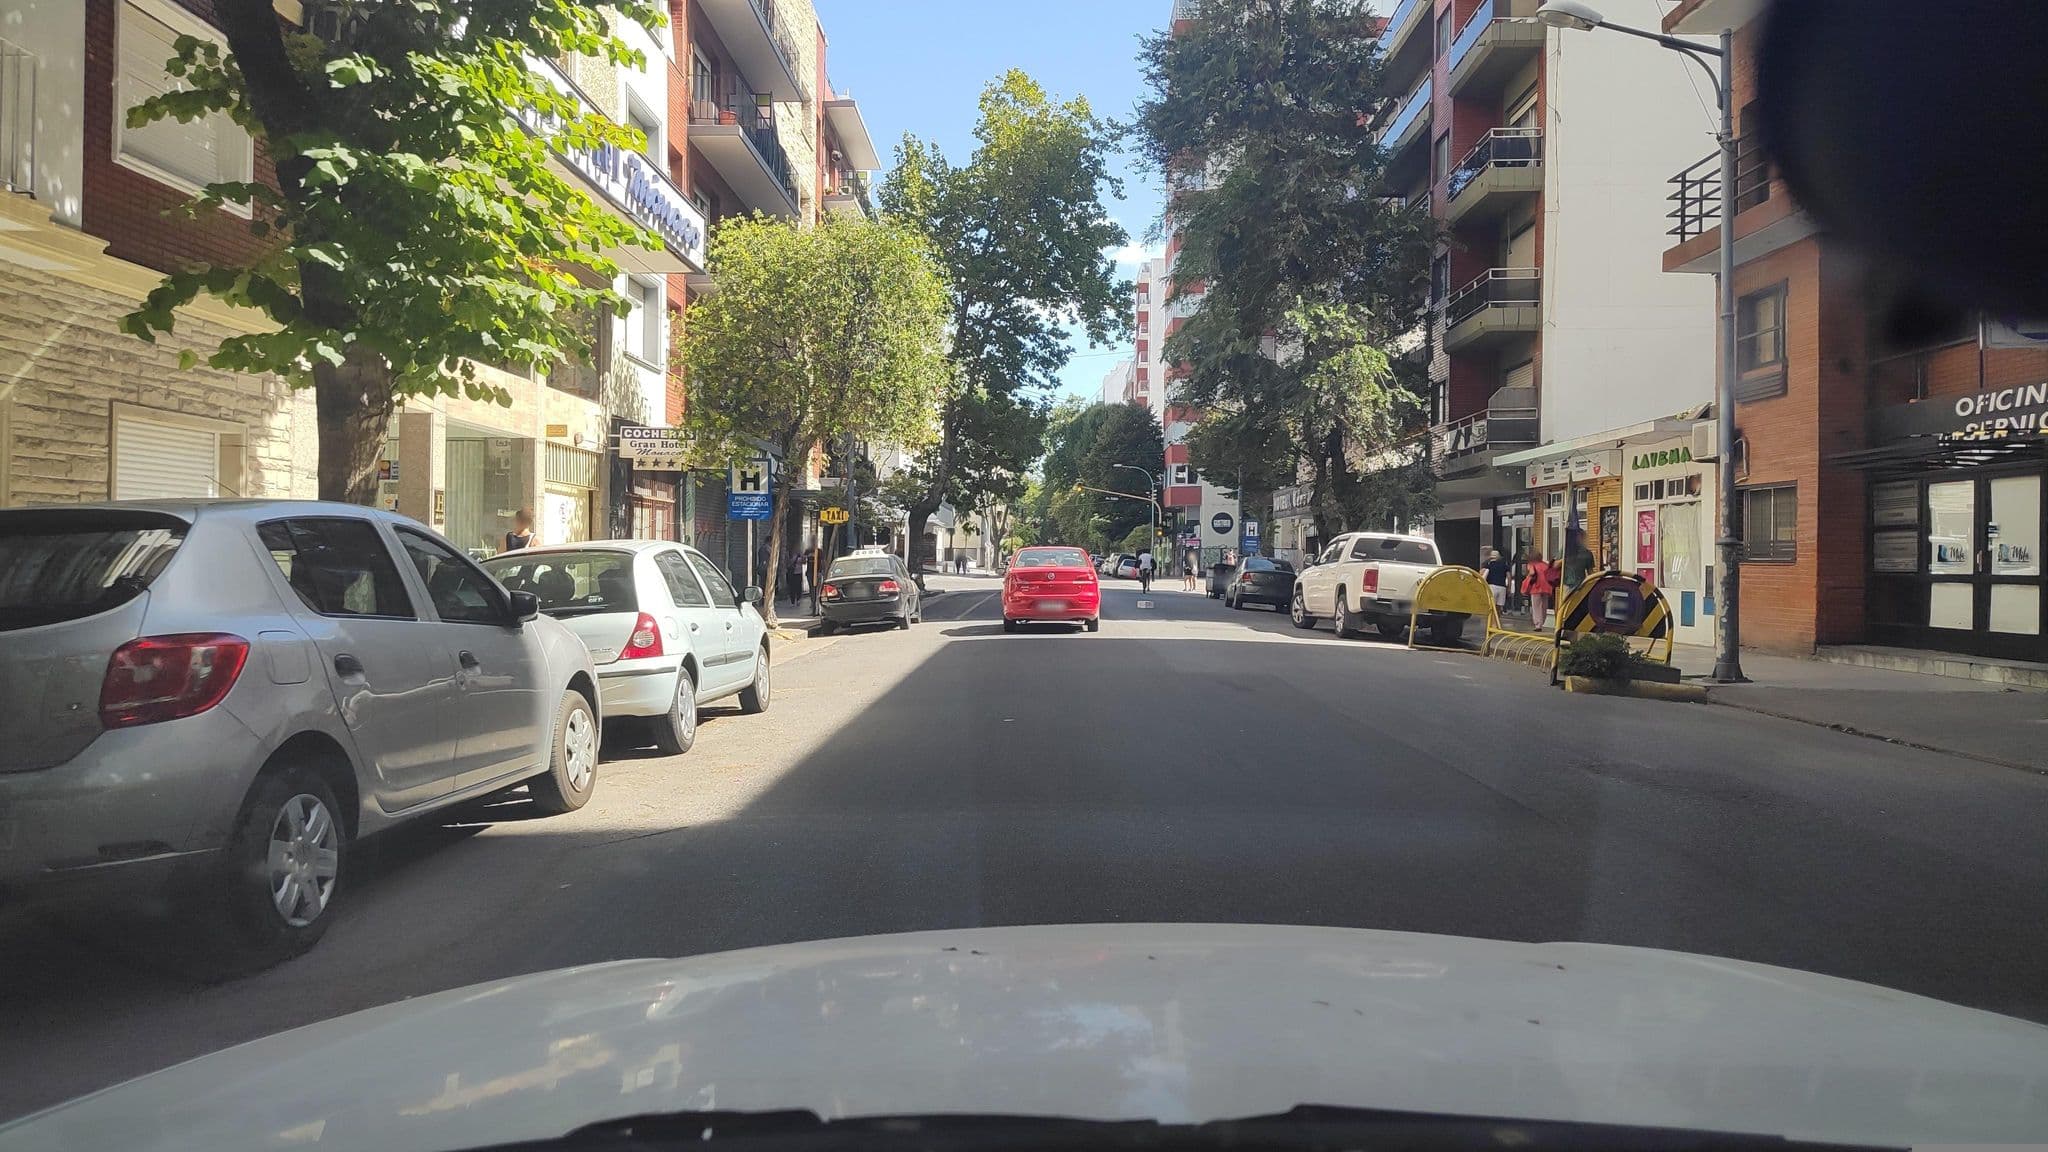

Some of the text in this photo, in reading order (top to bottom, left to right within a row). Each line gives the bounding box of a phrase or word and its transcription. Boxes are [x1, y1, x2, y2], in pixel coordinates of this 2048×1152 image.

[1955, 383, 2048, 417] OFICIN
[624, 428, 695, 439] COCHERAS
[629, 440, 656, 449] Gran
[740, 470, 761, 491] H
[827, 510, 845, 521] TAXI
[1248, 526, 1256, 536] H
